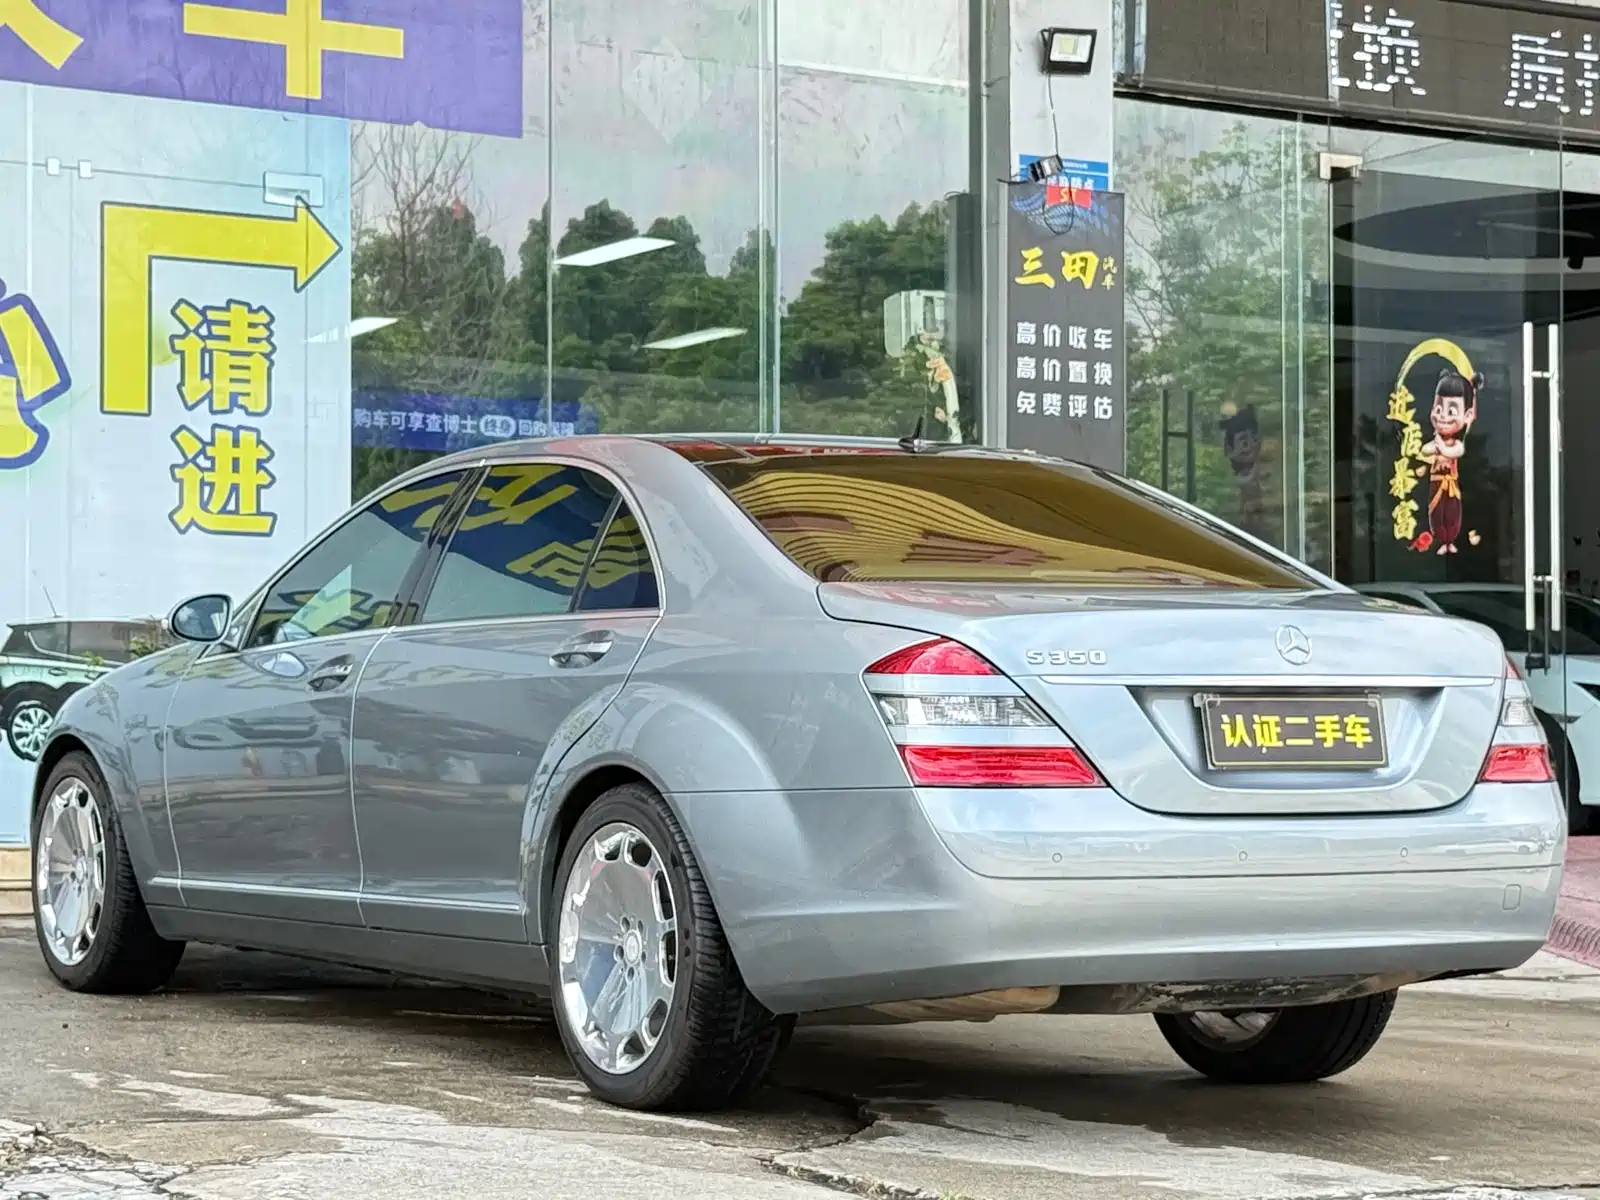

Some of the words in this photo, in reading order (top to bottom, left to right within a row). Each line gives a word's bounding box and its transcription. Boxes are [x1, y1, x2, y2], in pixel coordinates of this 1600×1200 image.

[1015, 246, 1099, 290] 三田
[1102, 256, 1118, 290] 汽车
[1017, 321, 1112, 350] 高价收车
[1017, 356, 1112, 386] 高价置换
[169, 298, 277, 537] 请进
[1017, 390, 1112, 420] 免费评估
[1221, 714, 1373, 749] 认证二手车
